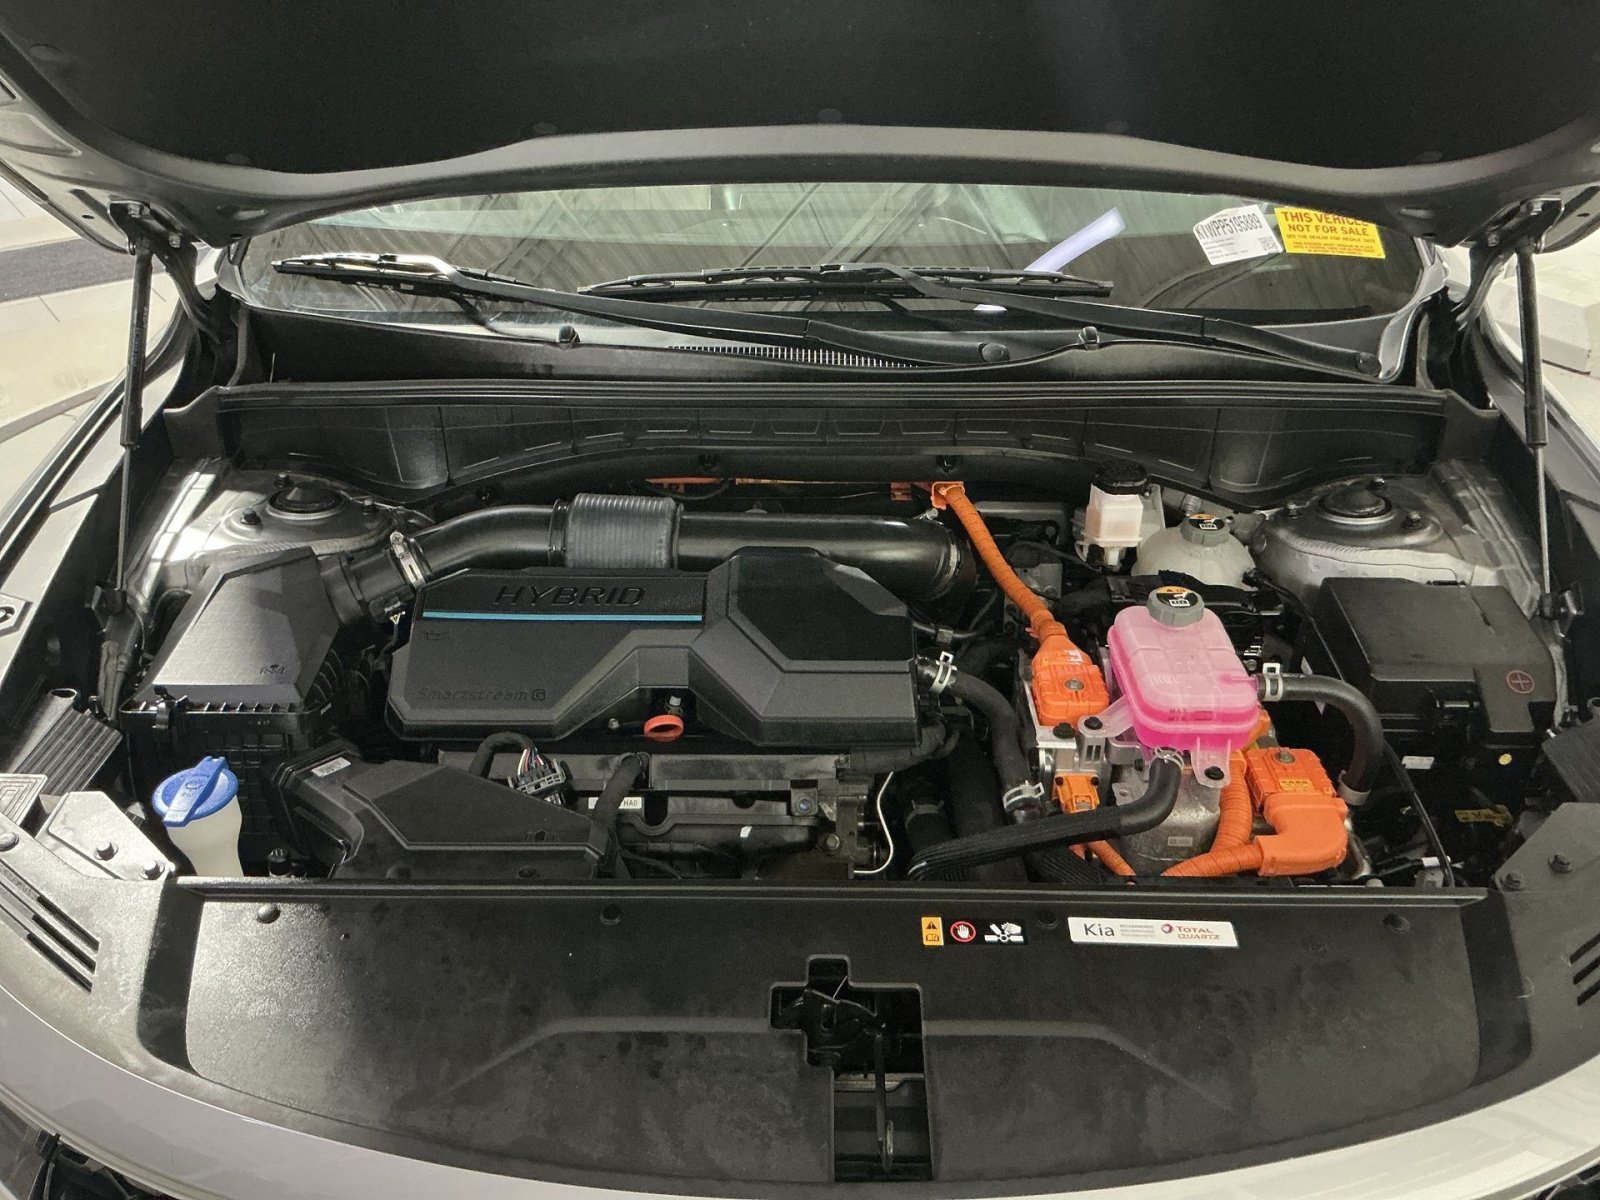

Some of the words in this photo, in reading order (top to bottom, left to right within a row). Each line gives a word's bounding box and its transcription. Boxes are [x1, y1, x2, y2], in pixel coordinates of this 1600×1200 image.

[1282, 211, 1313, 223] THIS
[1288, 224, 1311, 233] NOT
[1315, 225, 1338, 234] FOR
[1341, 226, 1370, 236] SALE
[494, 585, 646, 606] HYBRID
[1083, 923, 1115, 937] Kia
[1176, 925, 1213, 934] TOTAL
